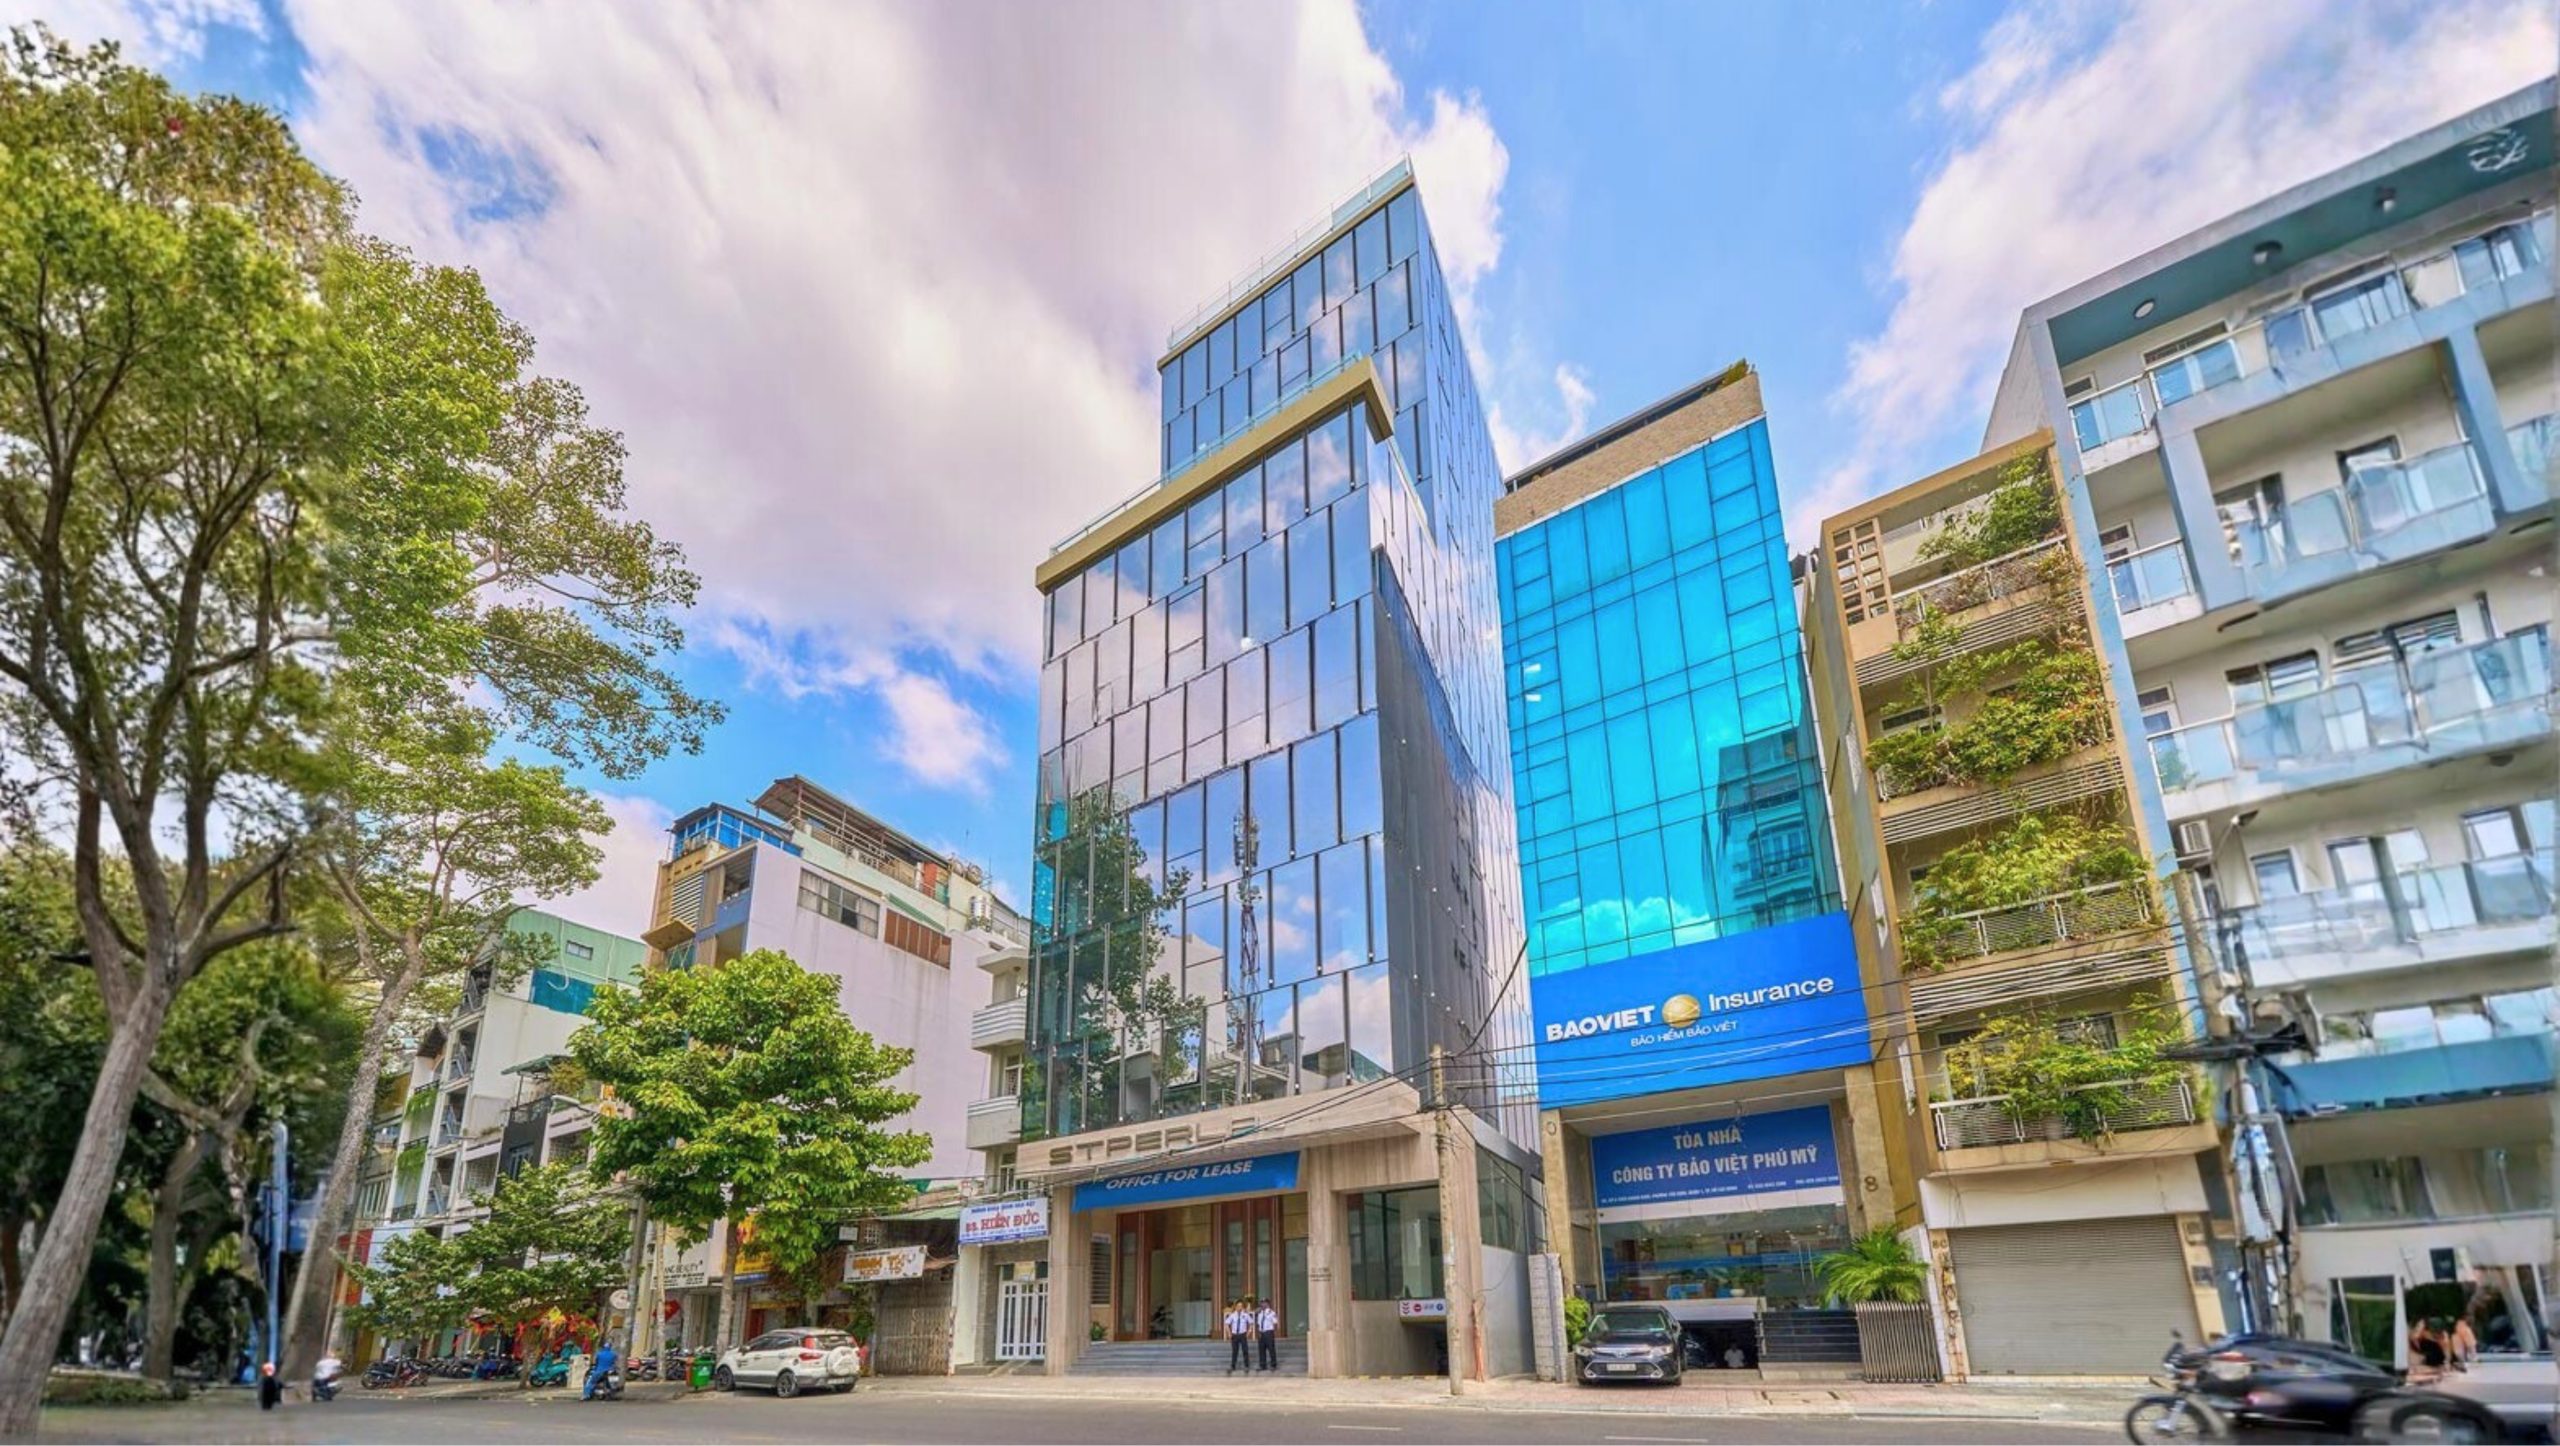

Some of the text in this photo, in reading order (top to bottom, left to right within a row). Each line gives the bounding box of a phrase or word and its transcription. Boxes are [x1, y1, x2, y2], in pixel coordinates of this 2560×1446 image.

[1546, 976, 1834, 1042] BAOVIET Insurance
[1674, 1126, 1743, 1150] TÒA NHÀ
[1106, 1160, 1254, 1190] OFFICE FOR LEASE
[1613, 1144, 1818, 1184] CÔNG TY BẢO VIỆT PHÚ MỸ
[1864, 1175, 1879, 1192] 8
